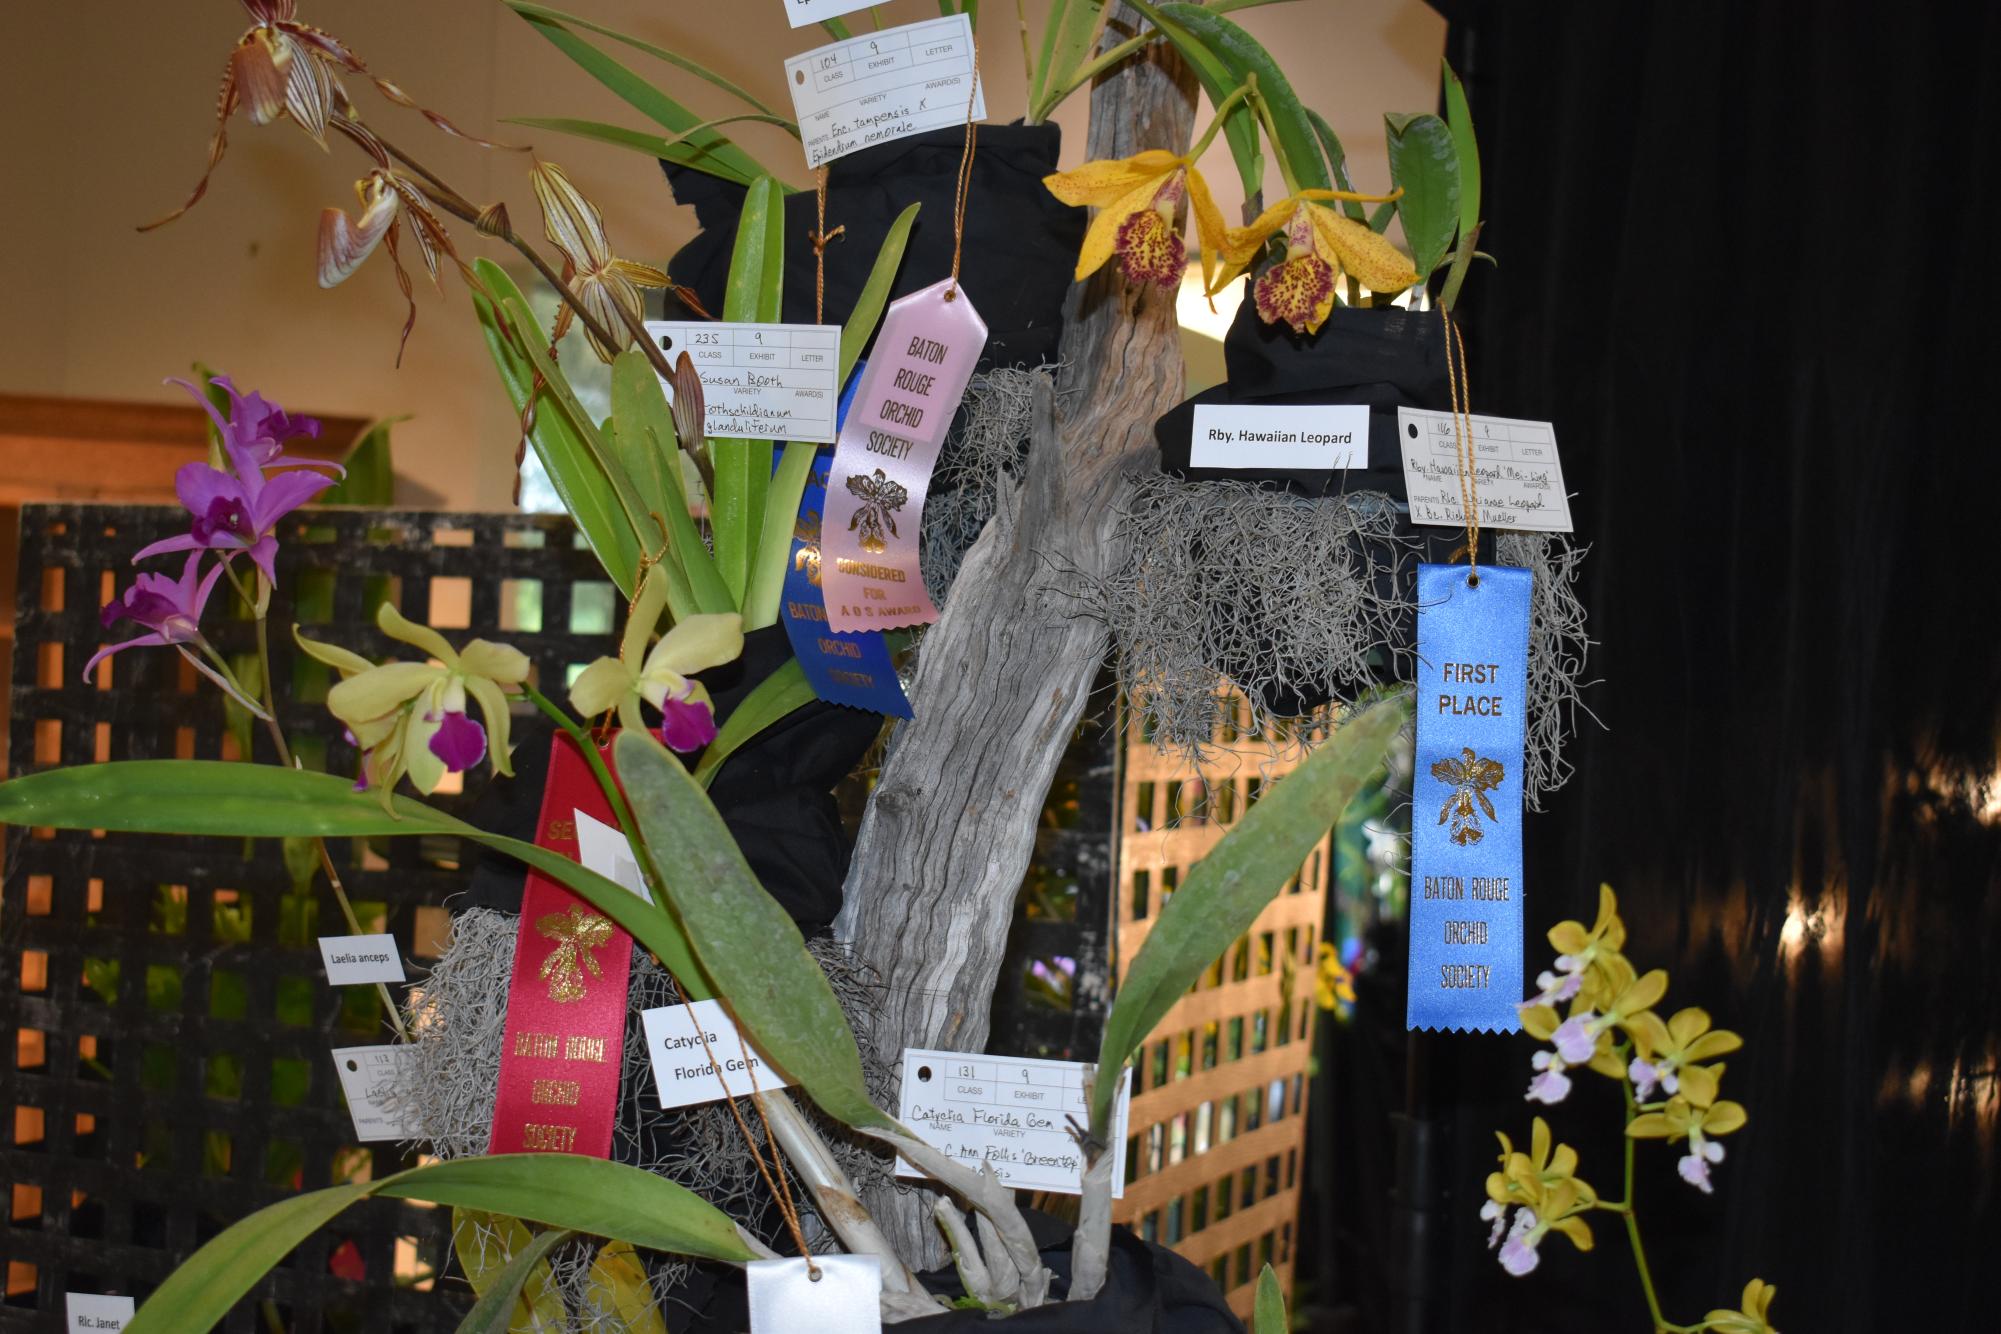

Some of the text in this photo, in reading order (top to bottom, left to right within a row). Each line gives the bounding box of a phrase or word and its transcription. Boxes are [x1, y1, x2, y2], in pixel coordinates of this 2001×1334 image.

[870, 41, 879, 55] 9
[820, 54, 837, 70] 104
[824, 45, 953, 83] CLASS EXHIBIT LETTER
[814, 77, 961, 121] NAME VARIETY AWARD(S)
[854, 107, 910, 128] tampensis
[695, 333, 719, 345] 235
[755, 332, 763, 345] 9
[698, 351, 824, 363] CLASS EXHIBIT LETTER
[907, 336, 948, 365] BATON
[700, 371, 783, 388] Susan Booth
[893, 368, 936, 397] ROUGE
[733, 387, 824, 399] VARIETY AWARD(S)
[880, 399, 924, 429] ORCHID
[866, 430, 914, 461] SOCIETY
[1209, 429, 1352, 446] Rby. Hawaiian Leopard
[1521, 448, 1543, 456] LETTER
[836, 557, 906, 583] CONSIDERED
[863, 587, 887, 601] FOR
[878, 604, 921, 617] AWARD
[1443, 662, 1500, 684] FIRST
[1439, 694, 1503, 717] PLACE
[1424, 876, 1510, 901] BATON ROUGE
[1444, 920, 1488, 945] ORCHID
[331, 953, 390, 964] Laelia anceps
[1441, 964, 1491, 989] SOCIETY
[514, 1031, 608, 1062] BATON ROUGE
[958, 1066, 975, 1079] 131
[1022, 1069, 1030, 1084] 9
[957, 1085, 1045, 1101] CLASS EXHIBIT
[973, 1107, 1020, 1128] Florida
[1026, 1112, 1054, 1130] Gem
[523, 1123, 577, 1152] SOCIETY
[929, 1122, 1026, 1139] NAME VARIETY
[96, 1317, 120, 1330] Janet
